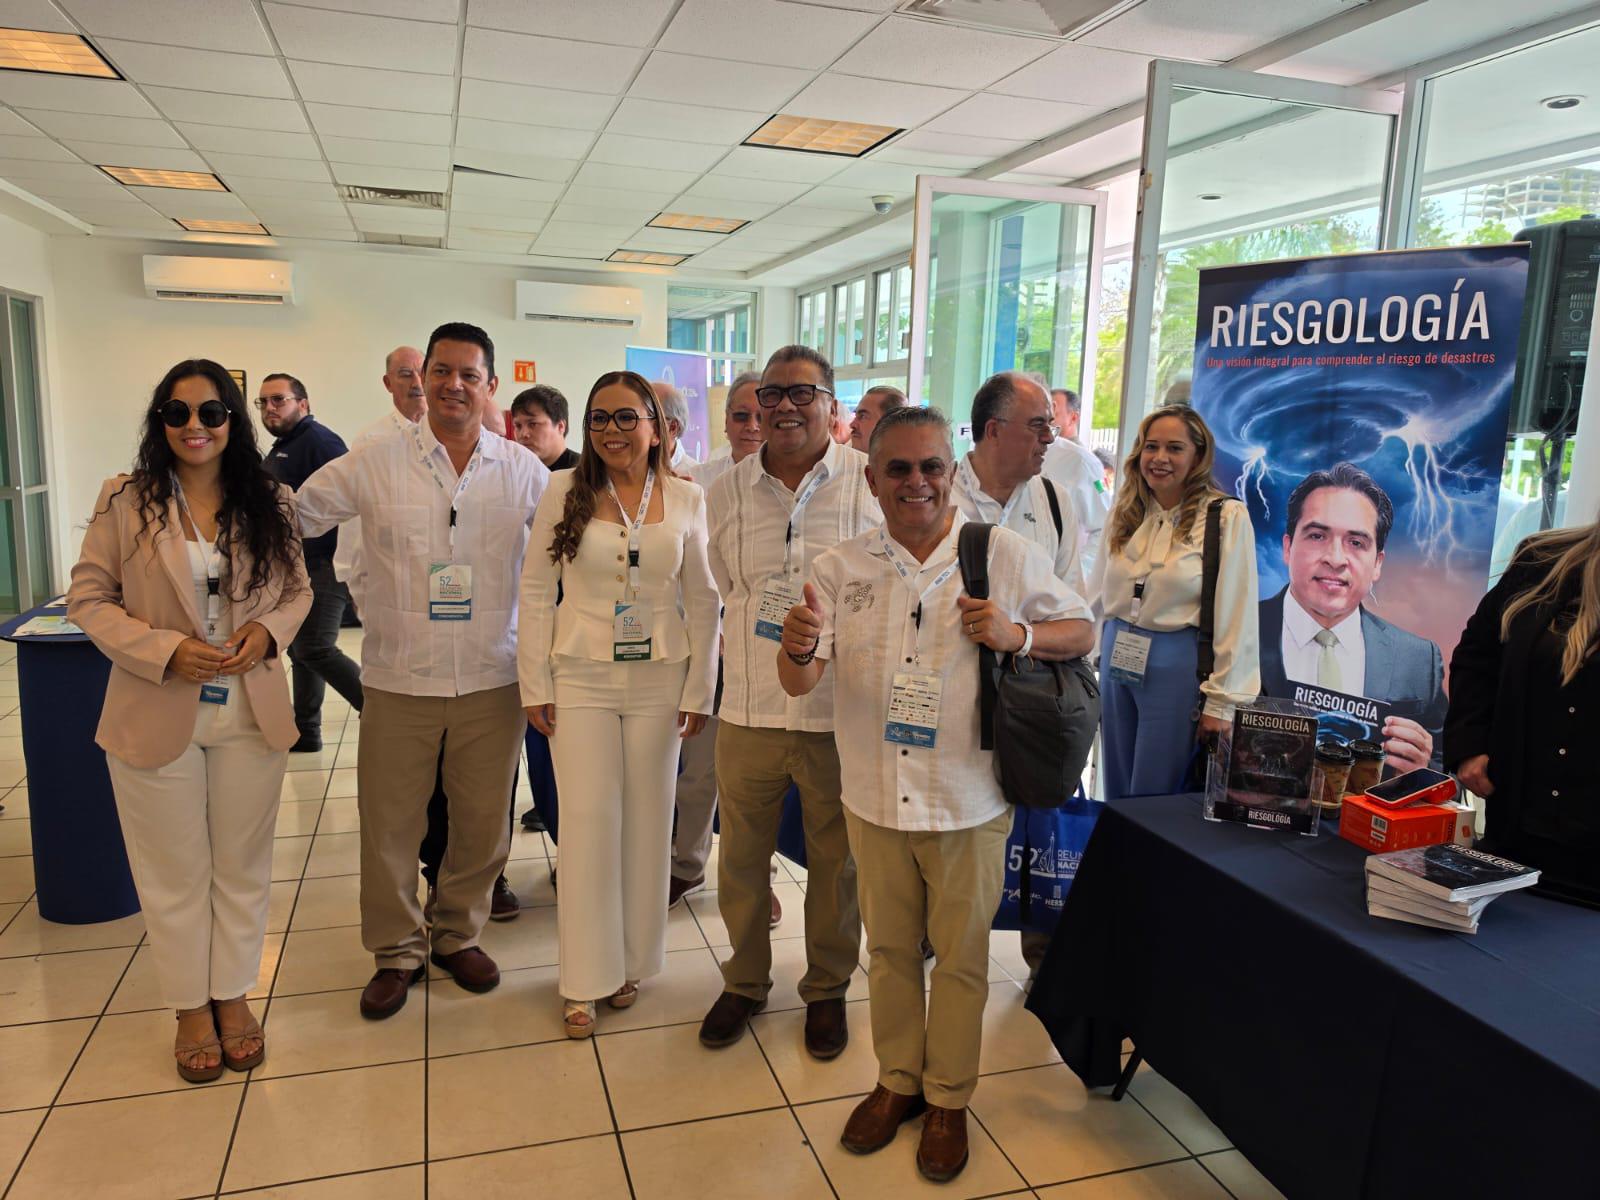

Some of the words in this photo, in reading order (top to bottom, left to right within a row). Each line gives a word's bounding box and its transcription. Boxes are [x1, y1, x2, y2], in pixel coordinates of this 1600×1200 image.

[1210, 278, 1490, 348] RIESGOLOGÍA
[1207, 357, 1223, 368] Una
[1226, 355, 1251, 368] visión
[1254, 355, 1290, 368] integral
[1291, 357, 1312, 368] para
[1315, 353, 1373, 368] comprender
[1376, 353, 1385, 365] el
[1389, 353, 1421, 367] riesgo
[1425, 352, 1438, 364] de
[1441, 352, 1496, 364] desastres
[1295, 686, 1378, 721] RIESGOLOGÍA
[1241, 712, 1310, 733] RIESGOLOGÍA
[1248, 809, 1291, 825] RIESGOLOGÍA
[1448, 844, 1526, 873] RIESGOLOGÍA
